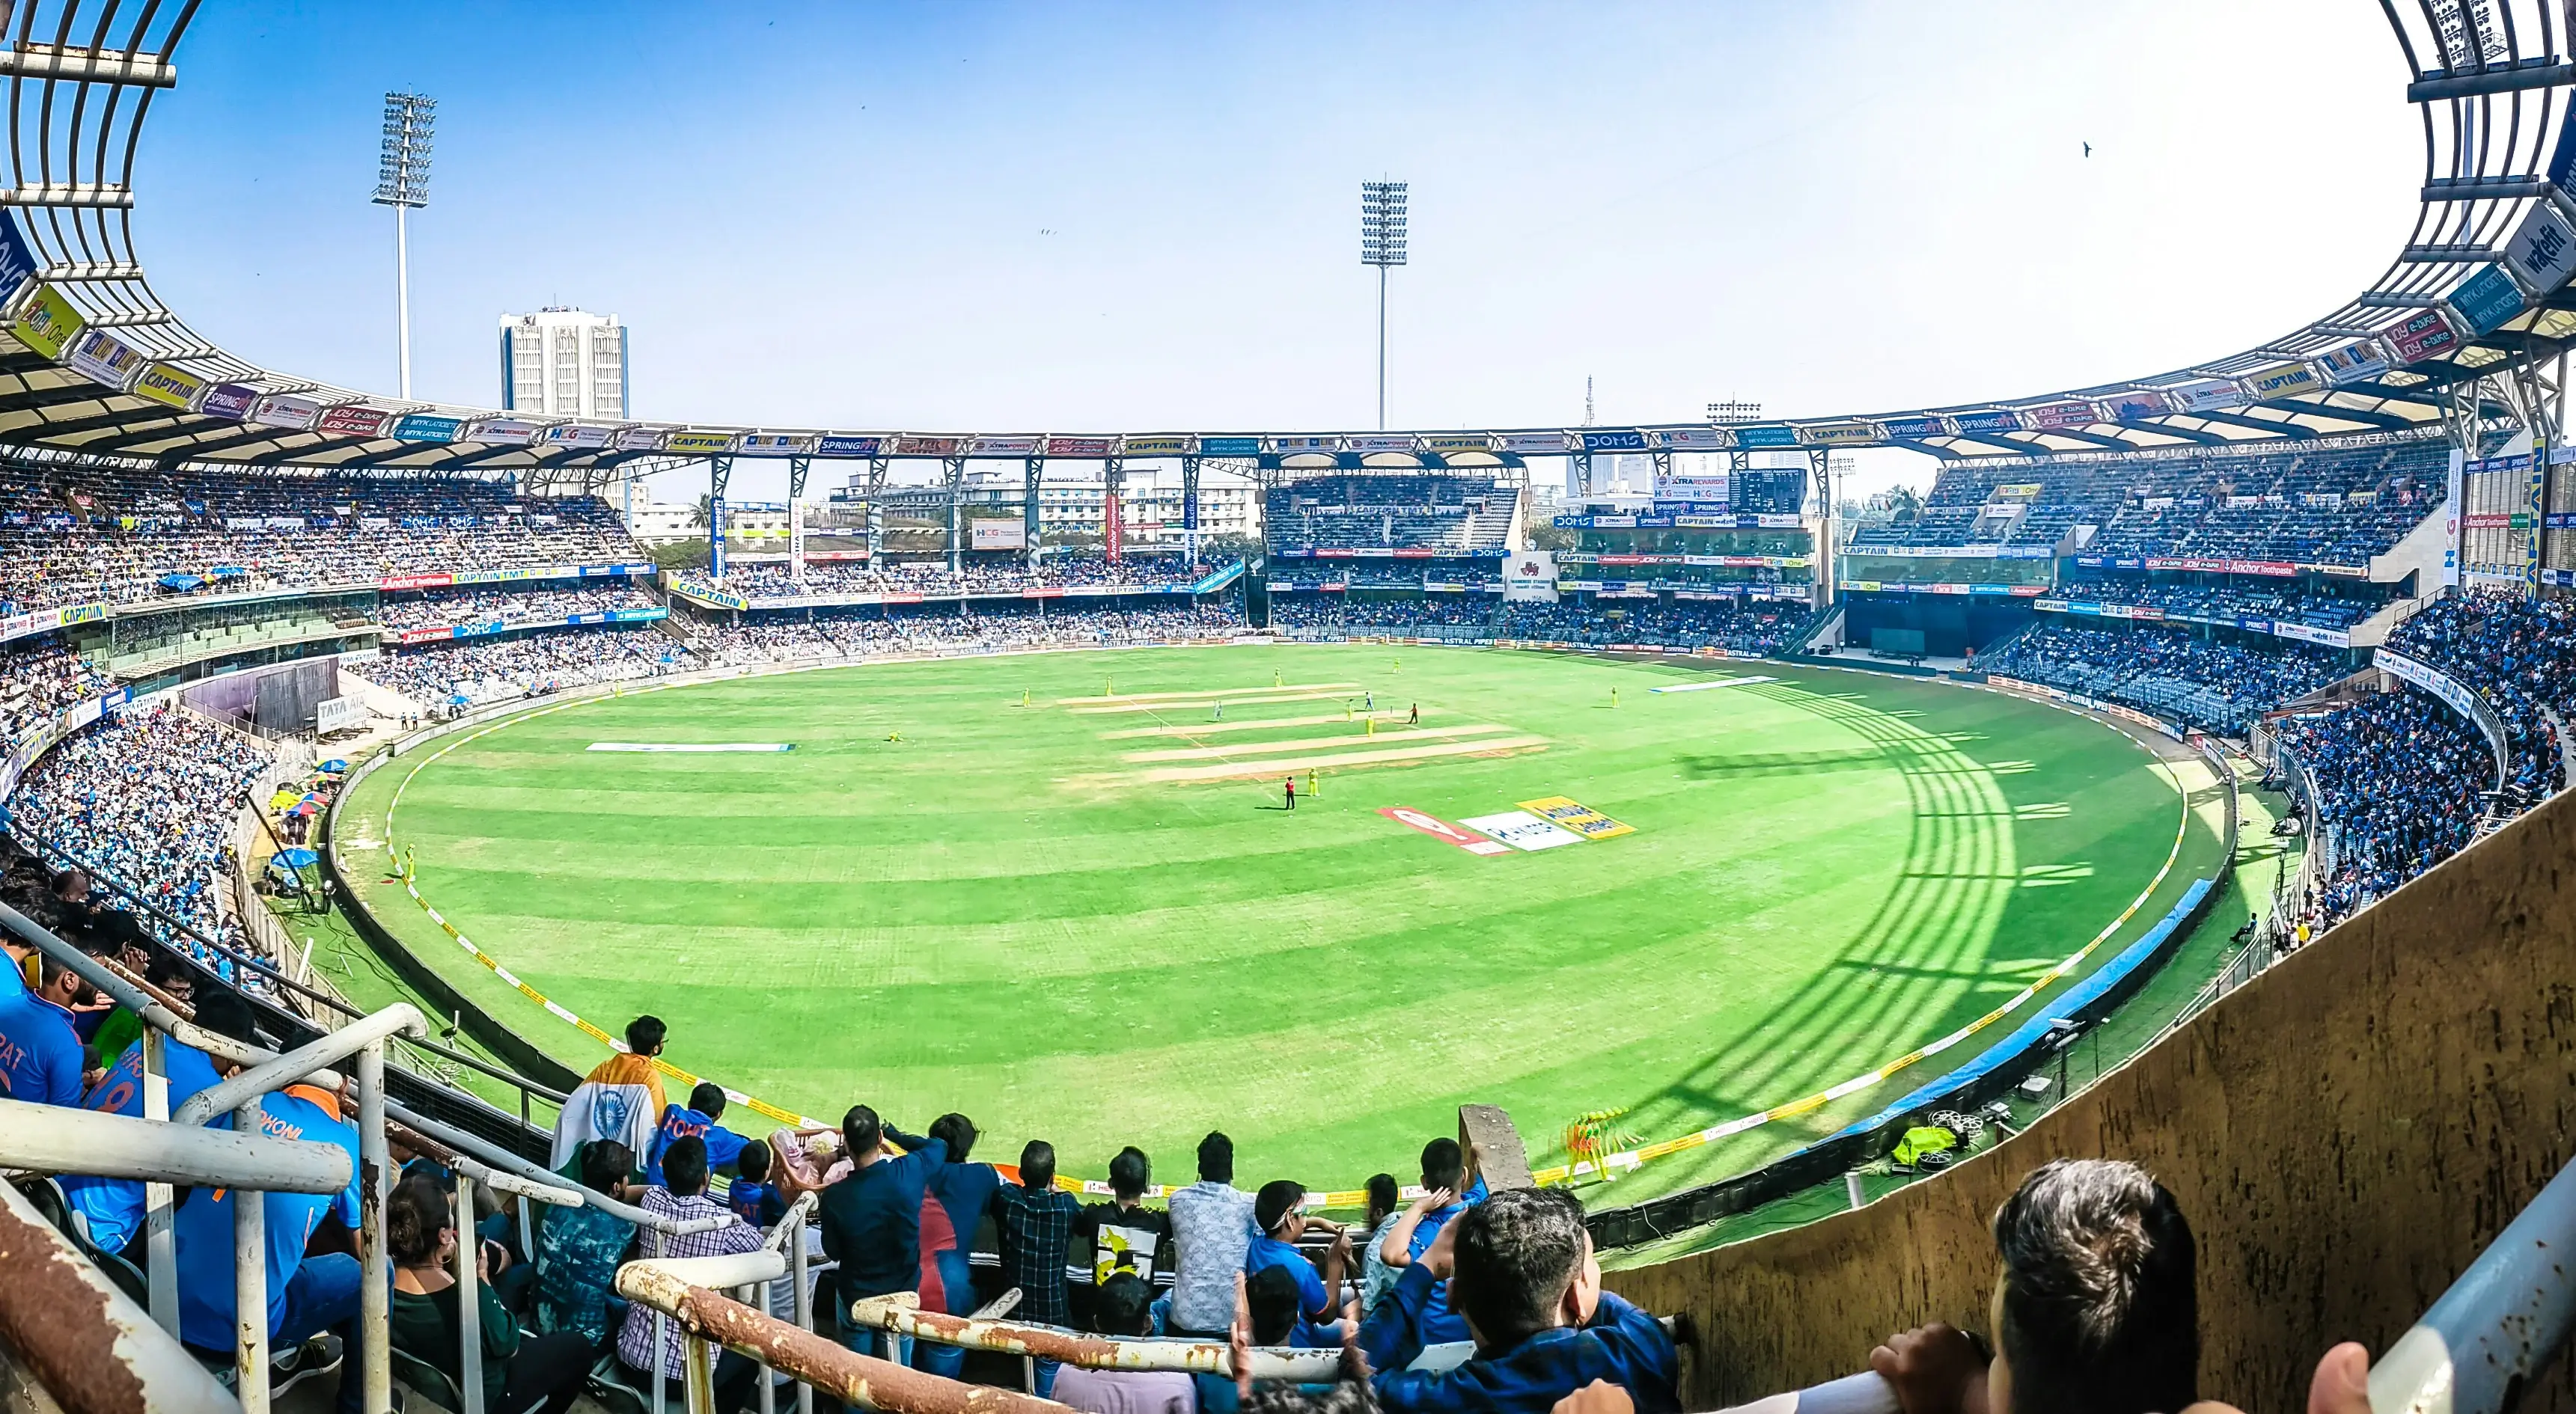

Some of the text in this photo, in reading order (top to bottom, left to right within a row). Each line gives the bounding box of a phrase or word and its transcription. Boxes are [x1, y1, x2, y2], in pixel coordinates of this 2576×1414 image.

[2523, 223, 2569, 275] wakefit
[2460, 270, 2506, 309] MYK LATICRETE
[2475, 290, 2521, 326] MYK LATICRETE
[21, 300, 66, 347] ZOHO One
[2390, 312, 2438, 343] JOY e-bike
[94, 339, 113, 361] LIC
[2402, 330, 2451, 358] JOY e-bike
[2360, 343, 2376, 360] LIC
[117, 352, 137, 371] LIC
[2335, 351, 2350, 367] LIC
[144, 372, 196, 400] CAPTAIN
[2256, 370, 2312, 392] CAPTAIN
[329, 408, 384, 420] JOY e-bike
[2036, 405, 2087, 417] JOY e-bike
[322, 420, 375, 432] JOY e-bike
[428, 420, 457, 429] LATICRETE
[2042, 414, 2094, 426] JOY e-bike
[421, 430, 451, 439] LATICRETE
[552, 428, 579, 439] HCG
[1661, 432, 1690, 441] HCG
[1815, 428, 1869, 439] CAPTAIN
[674, 438, 728, 447] CAPTAIN
[758, 437, 773, 445] LIC
[788, 437, 801, 445] LIC
[1128, 442, 1182, 450] CAPTAIN
[1586, 435, 1640, 447] DOMS
[1671, 476, 1725, 486] XTRAREWARDS
[1655, 489, 1672, 498] HCG
[1693, 489, 1712, 498] HCG
[1557, 517, 1592, 526] DOMS
[2467, 516, 2509, 527] Anchor Toothpaste
[2526, 447, 2544, 600] CAPTAIN
[977, 528, 999, 537] HCG
[1110, 532, 1118, 560] Anchor
[2444, 518, 2456, 569] HCG
[1843, 547, 1888, 555] CAPTAIN
[1788, 559, 1802, 567] One
[2230, 561, 2292, 575] Anchor Toothpaste
[457, 570, 525, 582] CAPTAIN TMT
[385, 578, 417, 590] Anchor
[678, 583, 740, 607] CAPTAIN
[64, 607, 103, 624] CAPTAIN
[463, 623, 495, 636] DOMS
[2312, 631, 2328, 640] wakefit
[1474, 637, 1493, 646] PIPES
[143, 696, 157, 706] TATA
[320, 701, 347, 719] TATA
[350, 695, 365, 710] AIA
[2070, 693, 2108, 711] ASTRAL PIPES
[122, 703, 135, 712] TATA
[21, 732, 47, 765] CAPTAIN
